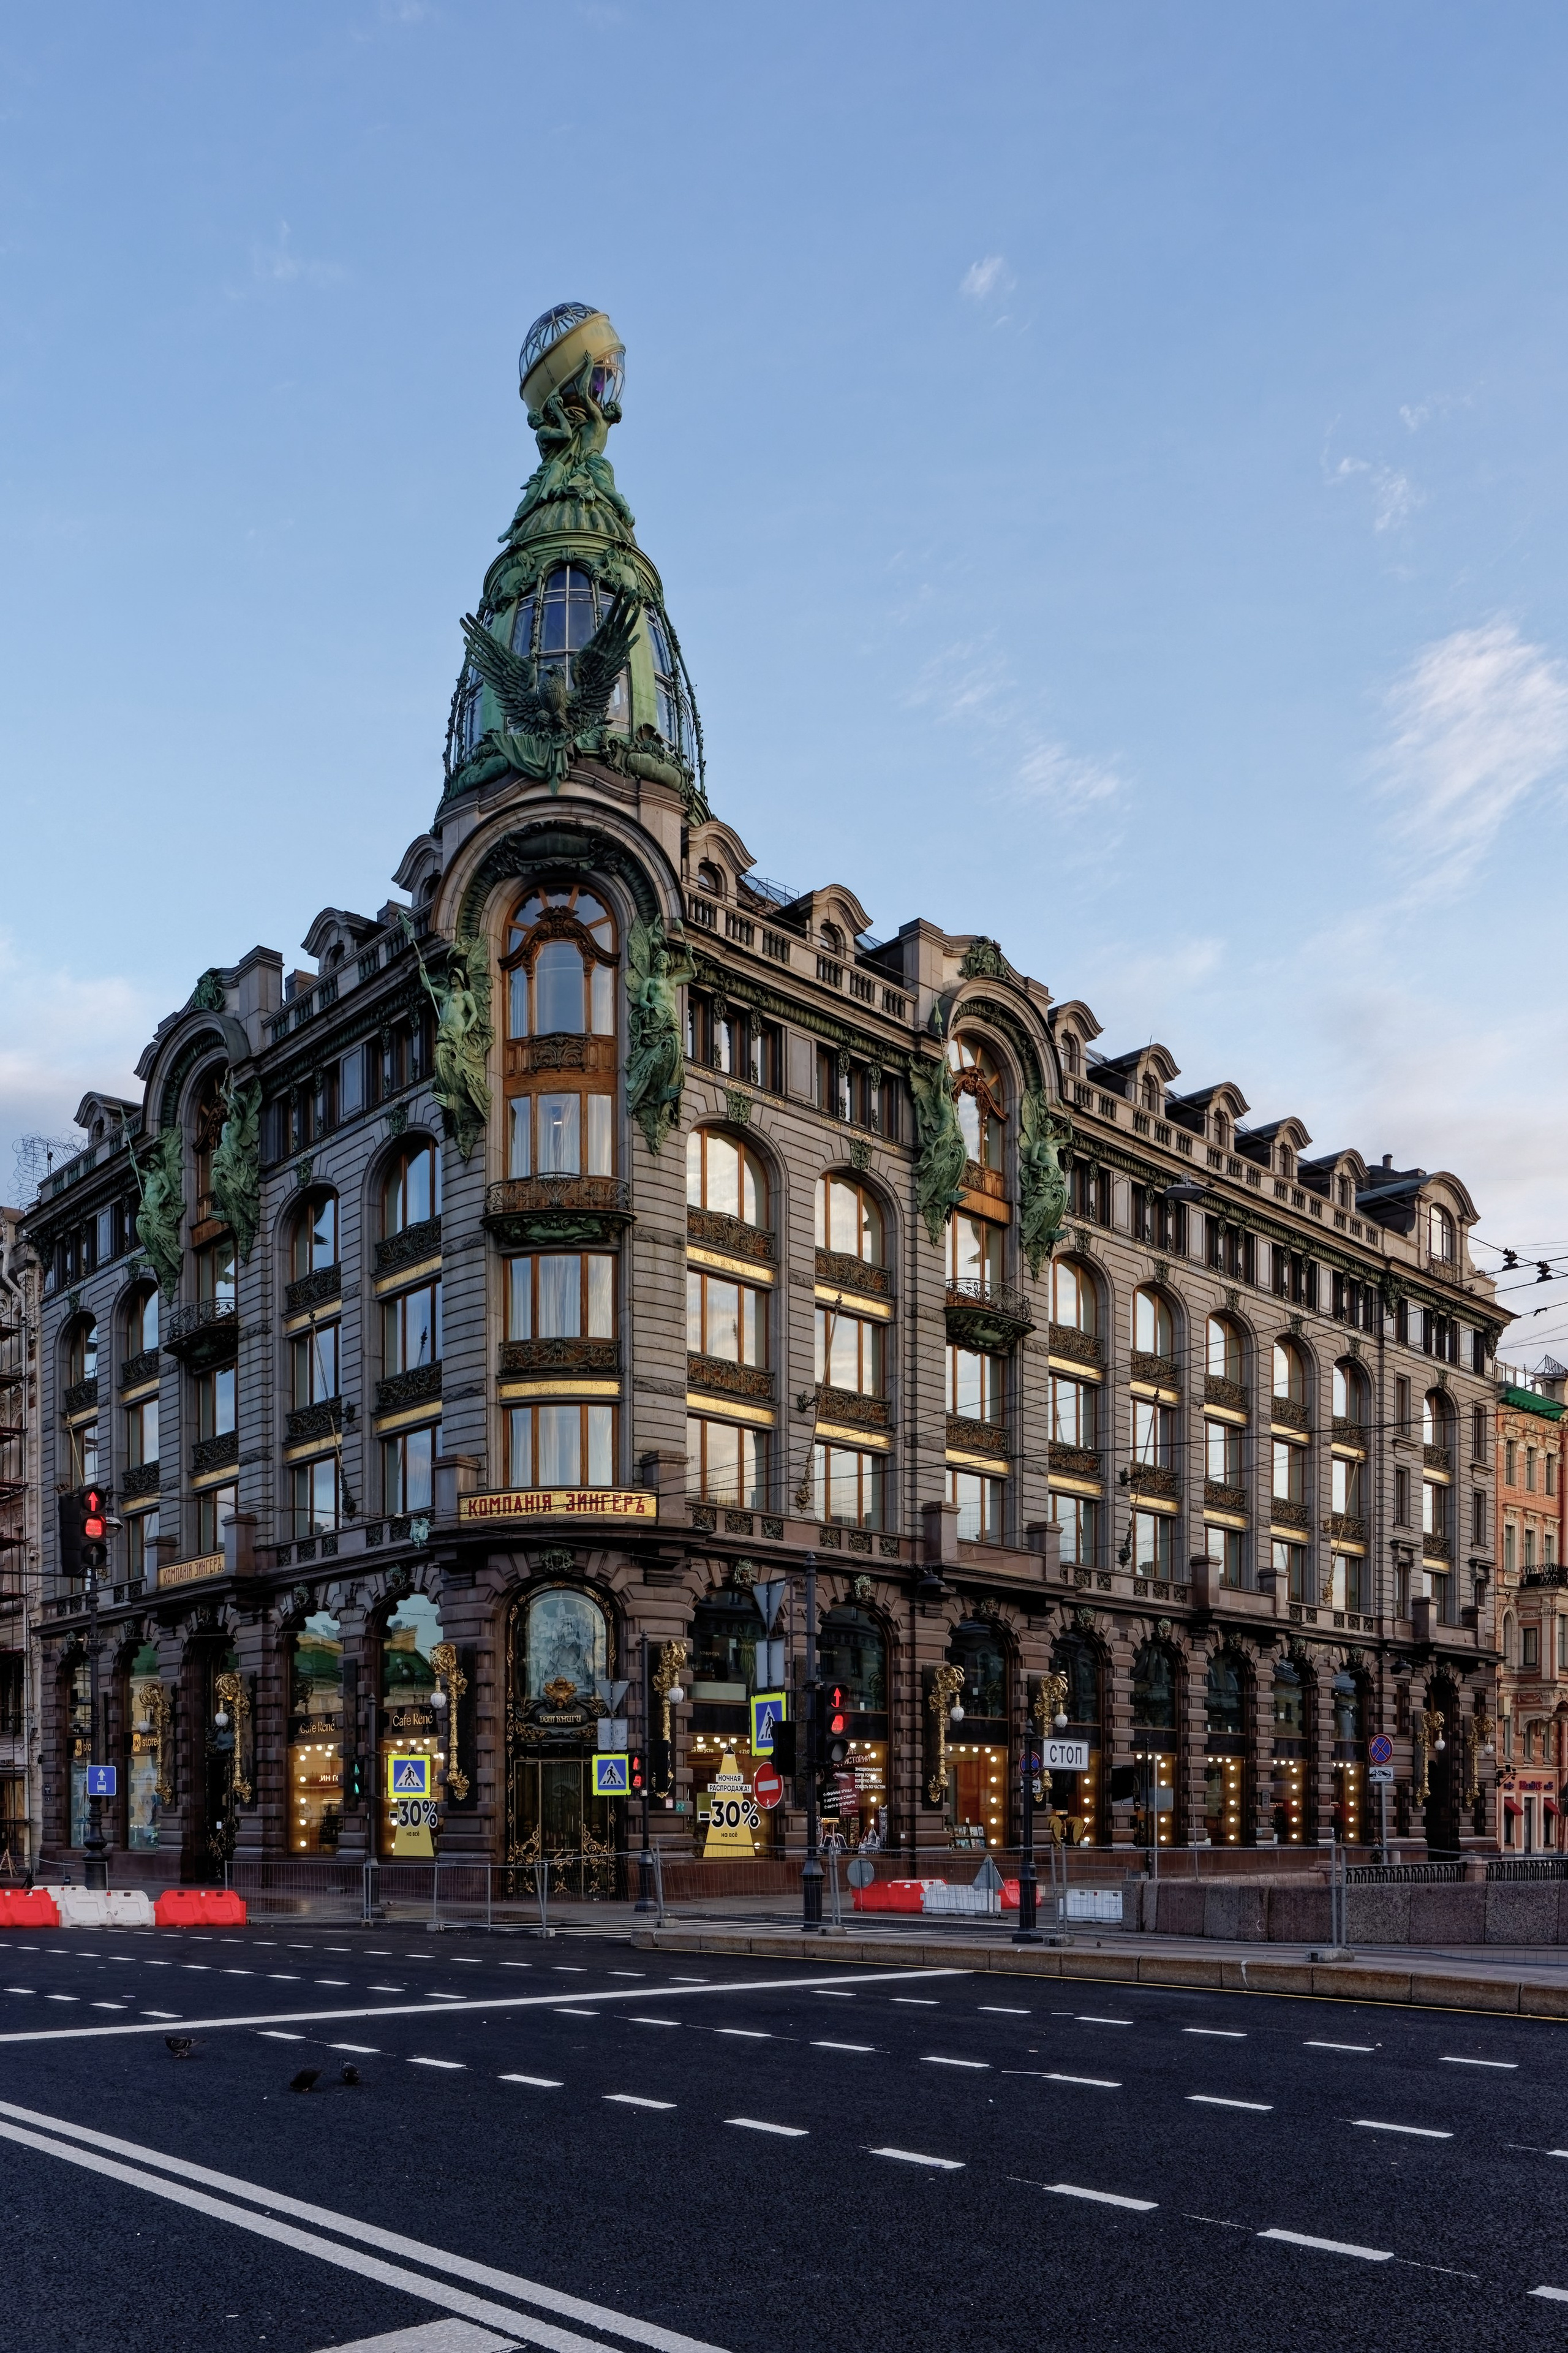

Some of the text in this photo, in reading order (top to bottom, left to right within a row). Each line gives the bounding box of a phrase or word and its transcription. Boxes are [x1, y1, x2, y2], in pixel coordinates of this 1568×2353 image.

[566, 1494, 645, 1514] ЗИНГЕРЪ
[300, 1718, 335, 1734] Cafe René
[393, 1710, 434, 1727] Cafe René
[83, 1742, 92, 1752] sto
[142, 1737, 157, 1747] store
[1050, 1745, 1082, 1764] СТОП
[389, 1799, 437, 1828] -30%
[698, 1800, 760, 1829] -30%
